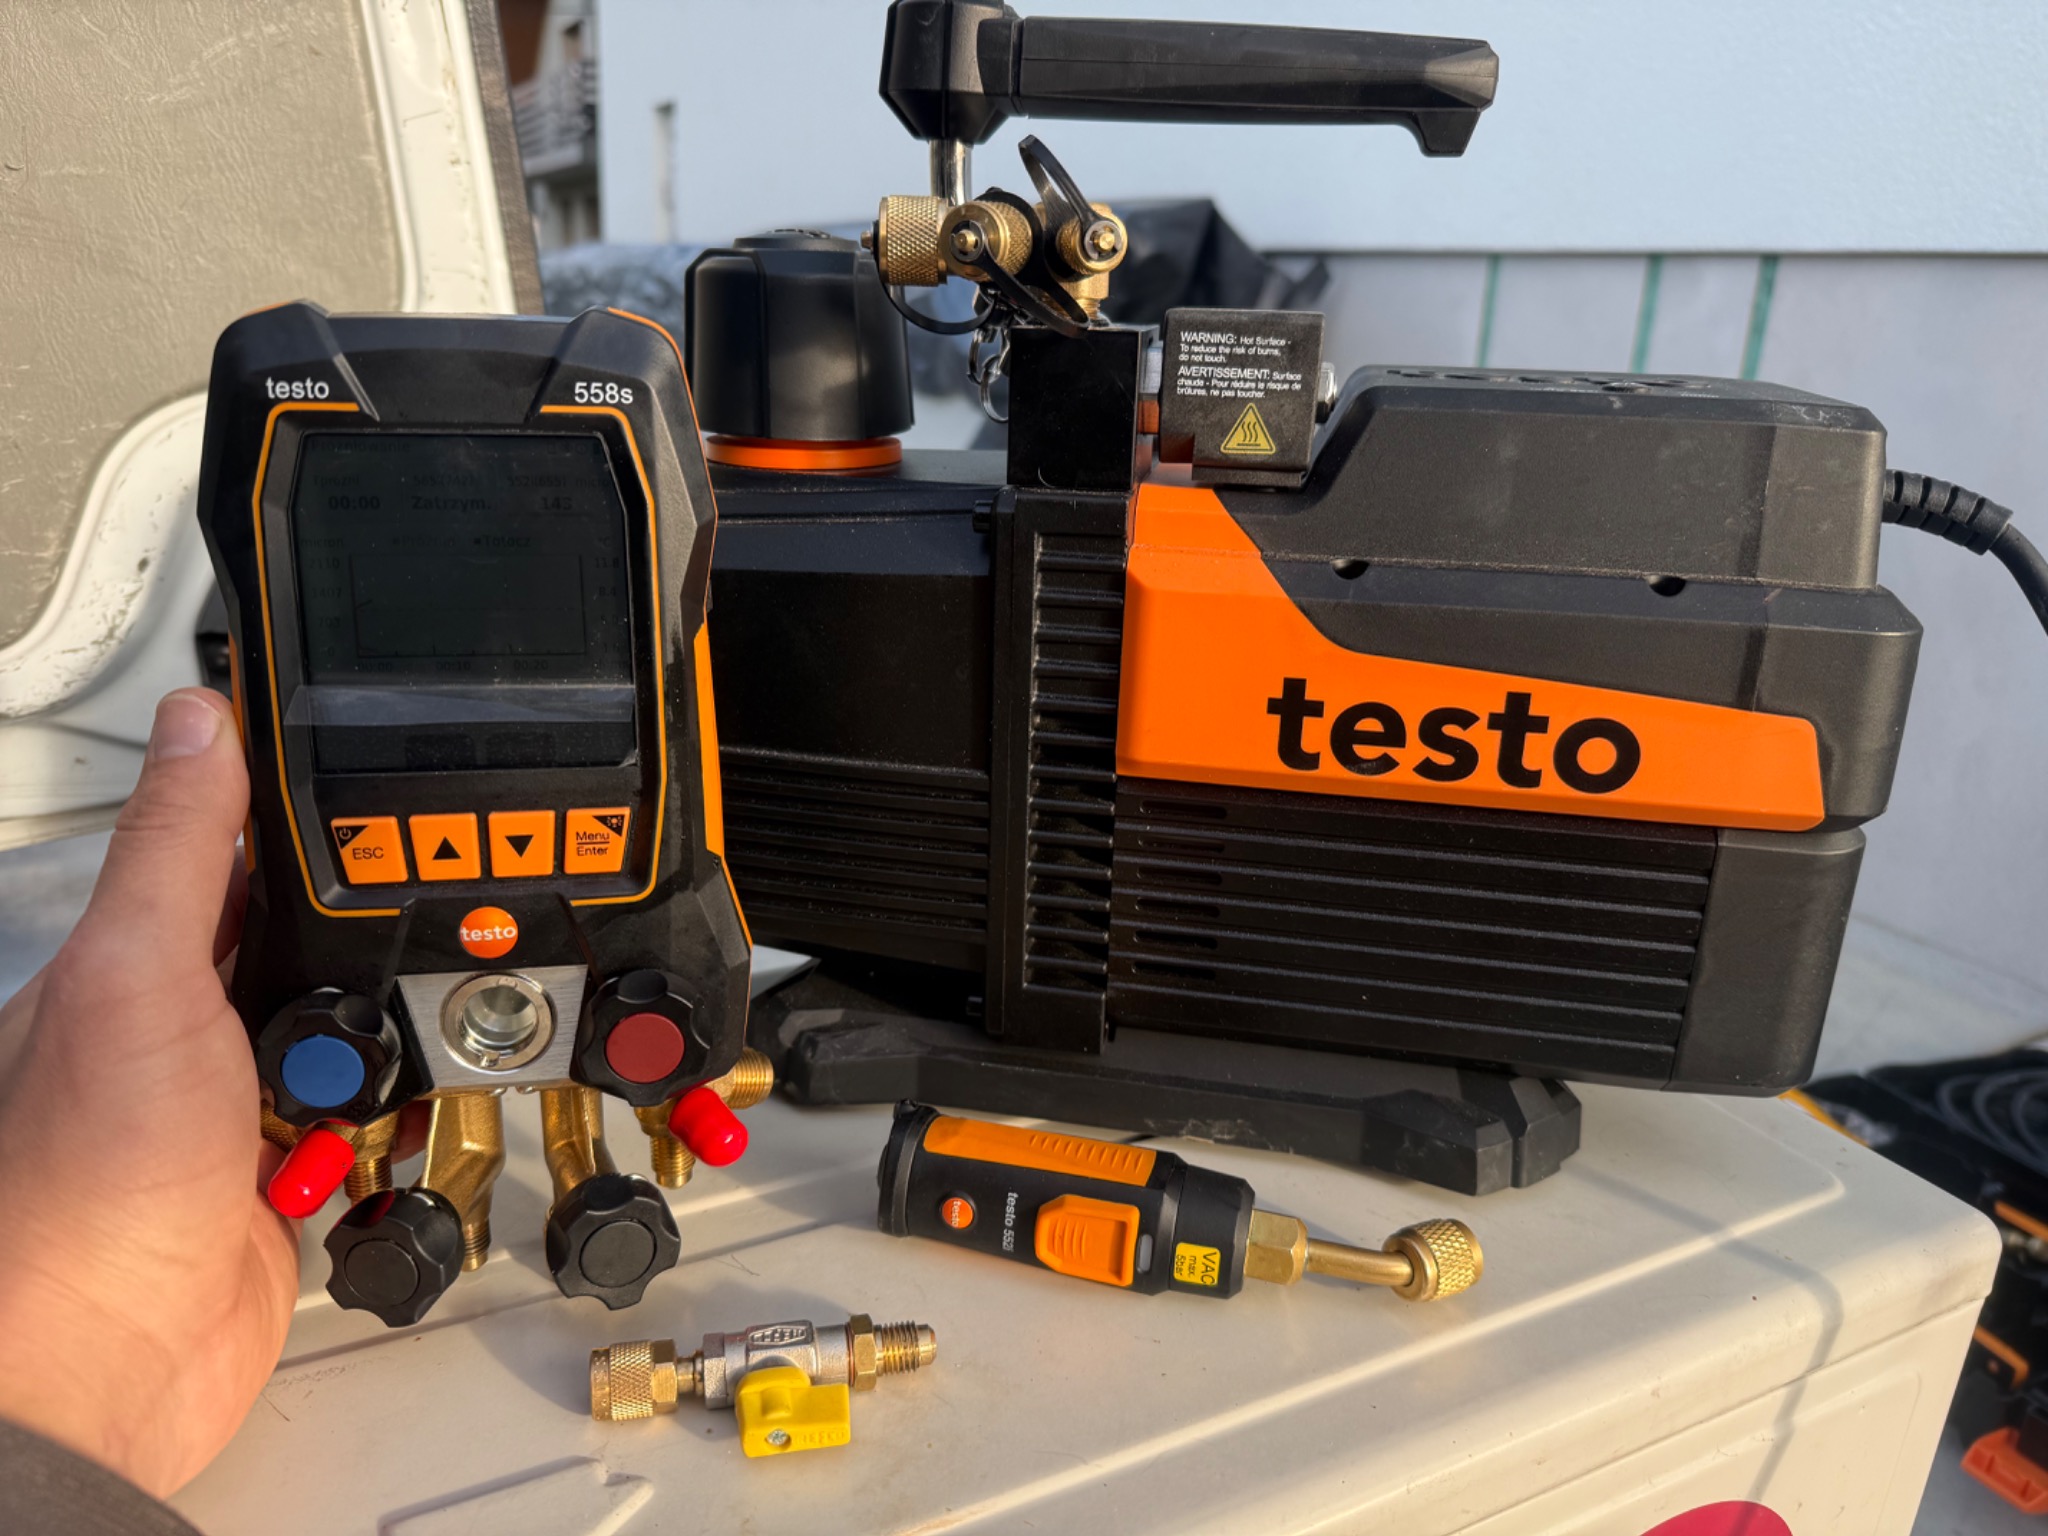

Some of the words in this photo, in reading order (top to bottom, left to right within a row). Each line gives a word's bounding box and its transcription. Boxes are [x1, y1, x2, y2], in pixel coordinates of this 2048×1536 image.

[1180, 331, 1238, 344] WARNING:
[1240, 336, 1254, 345] Hot
[1255, 336, 1286, 347] Surface
[1180, 343, 1190, 352] To
[1190, 345, 1217, 353] reduce
[1218, 345, 1231, 354] the
[1231, 346, 1246, 355] risk
[1247, 347, 1256, 355] of
[1178, 353, 1190, 361] do
[1190, 354, 1203, 362] not
[1204, 354, 1226, 363] touch.
[1177, 365, 1270, 380] AVERTISSEMENT:
[1271, 371, 1302, 381] Surface
[265, 377, 330, 399] testo
[574, 381, 634, 404] 558s
[1176, 378, 1204, 387] chaude
[1211, 379, 1230, 388] Pour
[1230, 380, 1256, 389] réduire
[1257, 381, 1265, 390] le
[1265, 381, 1290, 391] risque
[1290, 382, 1302, 391] de
[1210, 389, 1220, 397] ne
[1221, 389, 1235, 399] pas
[1237, 390, 1266, 398] toucher.
[328, 495, 380, 510] 00:00
[411, 495, 491, 513] Zatrzym.
[1266, 677, 1641, 794] testo
[575, 831, 610, 842] Menu
[352, 847, 384, 860] ESC
[576, 845, 609, 857] Enter
[460, 925, 517, 942] testo
[1004, 1192, 1019, 1227] testo
[1201, 1251, 1217, 1285] VAC
